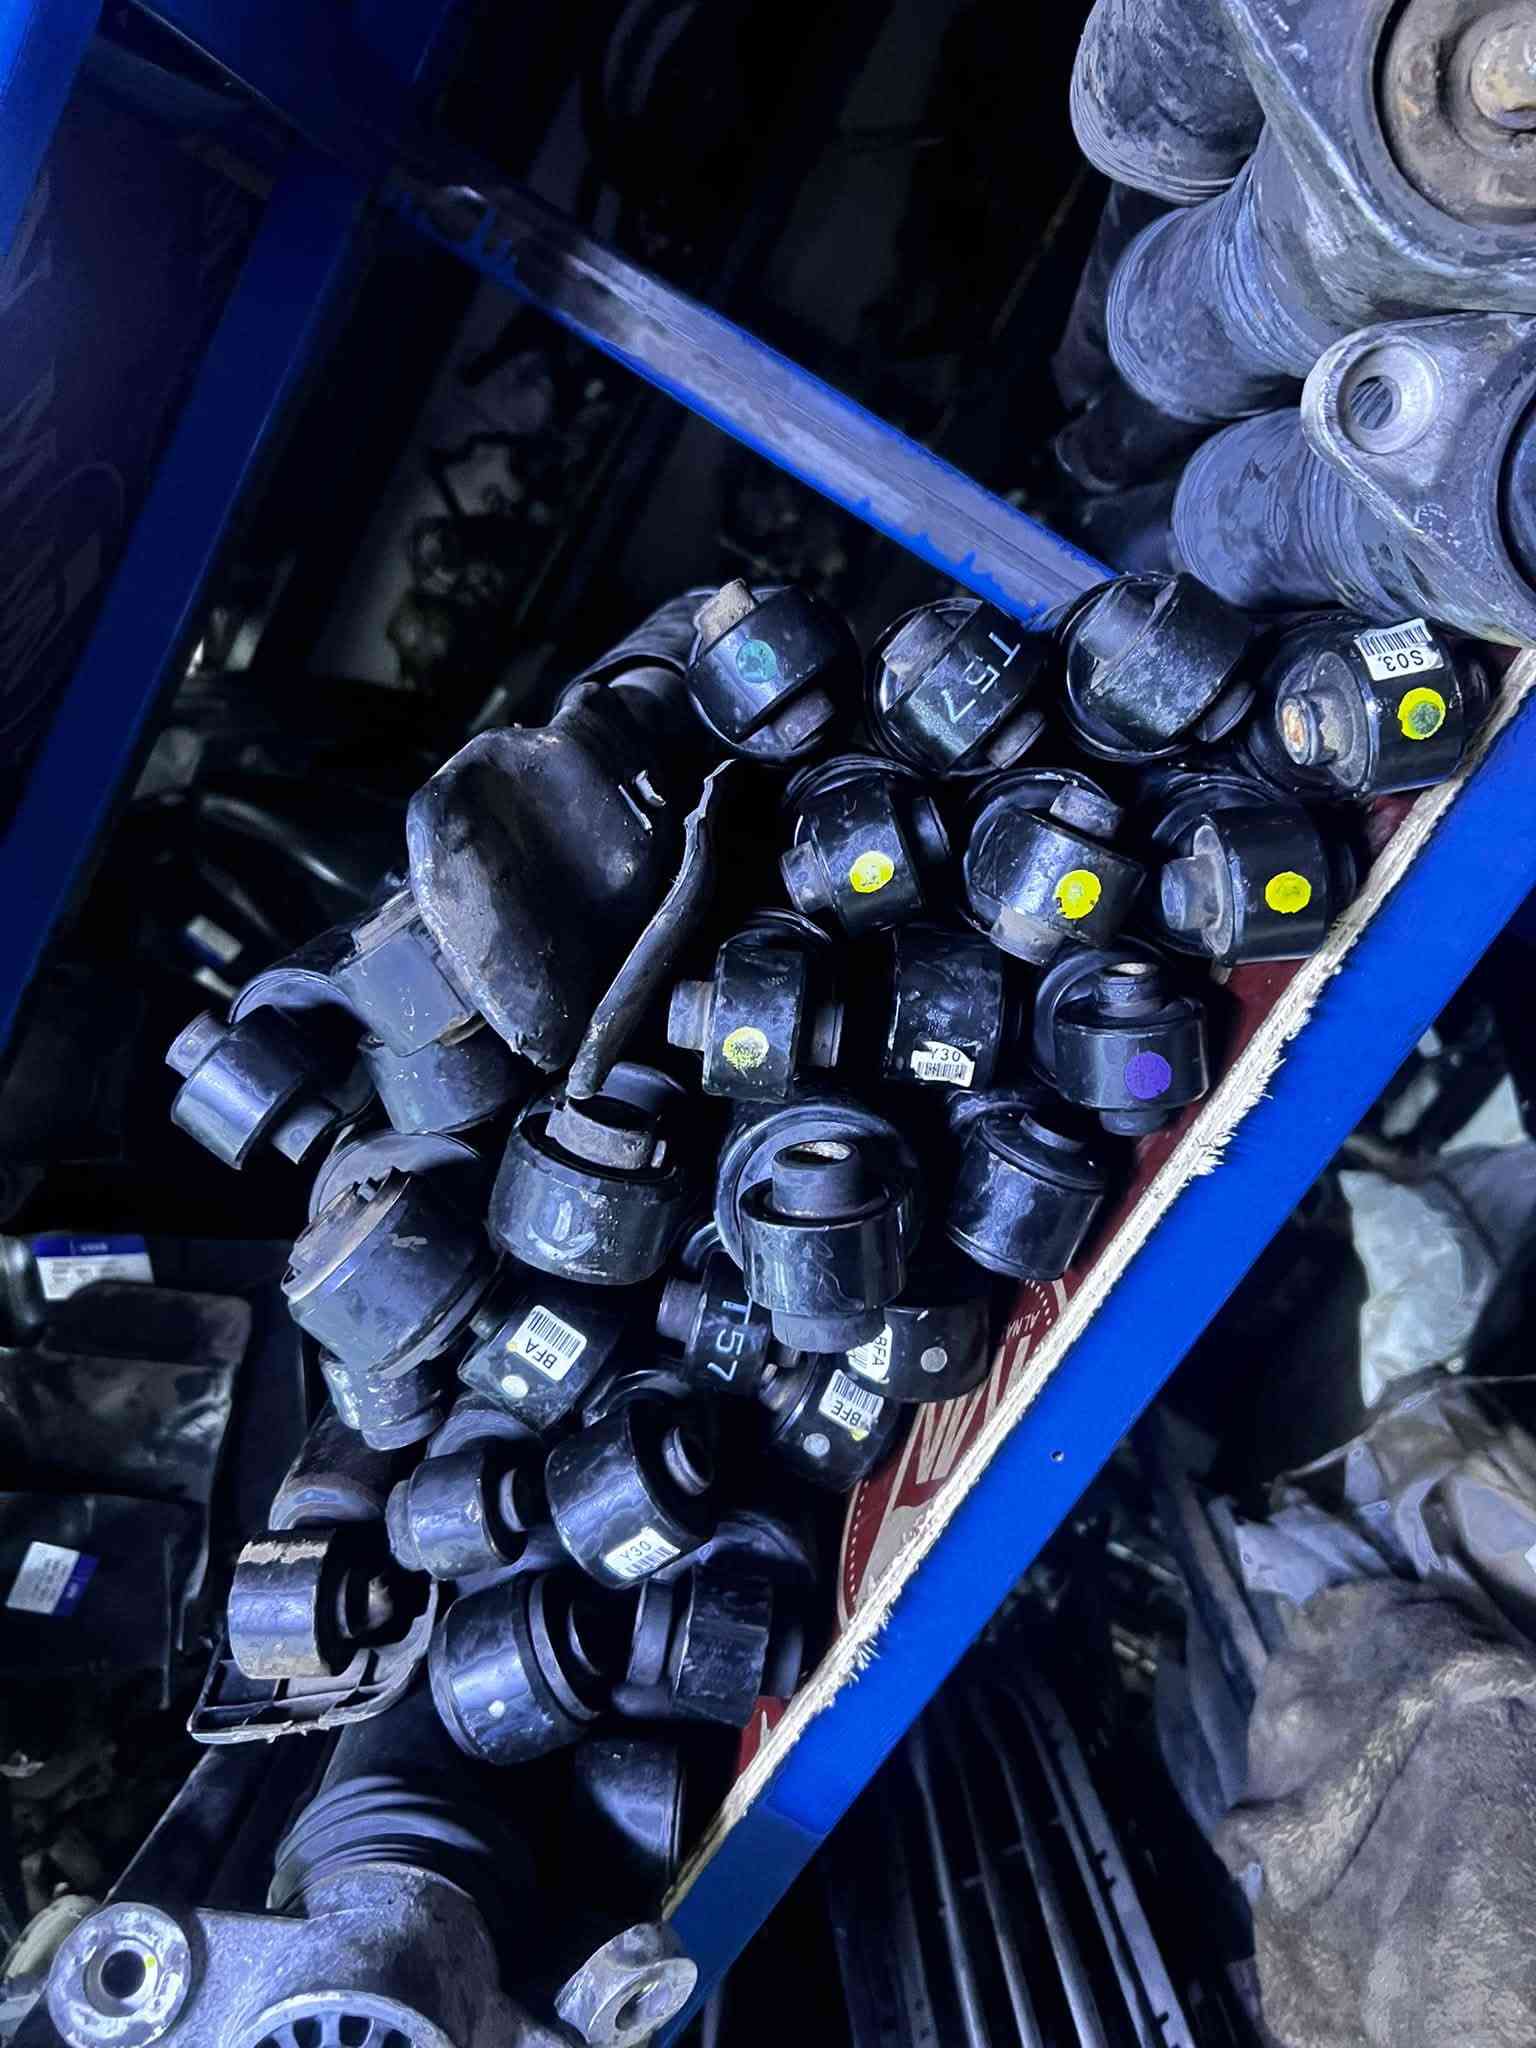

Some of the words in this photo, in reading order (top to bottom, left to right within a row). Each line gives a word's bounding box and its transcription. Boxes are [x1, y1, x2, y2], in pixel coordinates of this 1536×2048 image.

[941, 632, 1020, 723] T57
[525, 1338, 558, 1369] BFA
[831, 1400, 862, 1426] BFE
[619, 1540, 652, 1562] Y30
